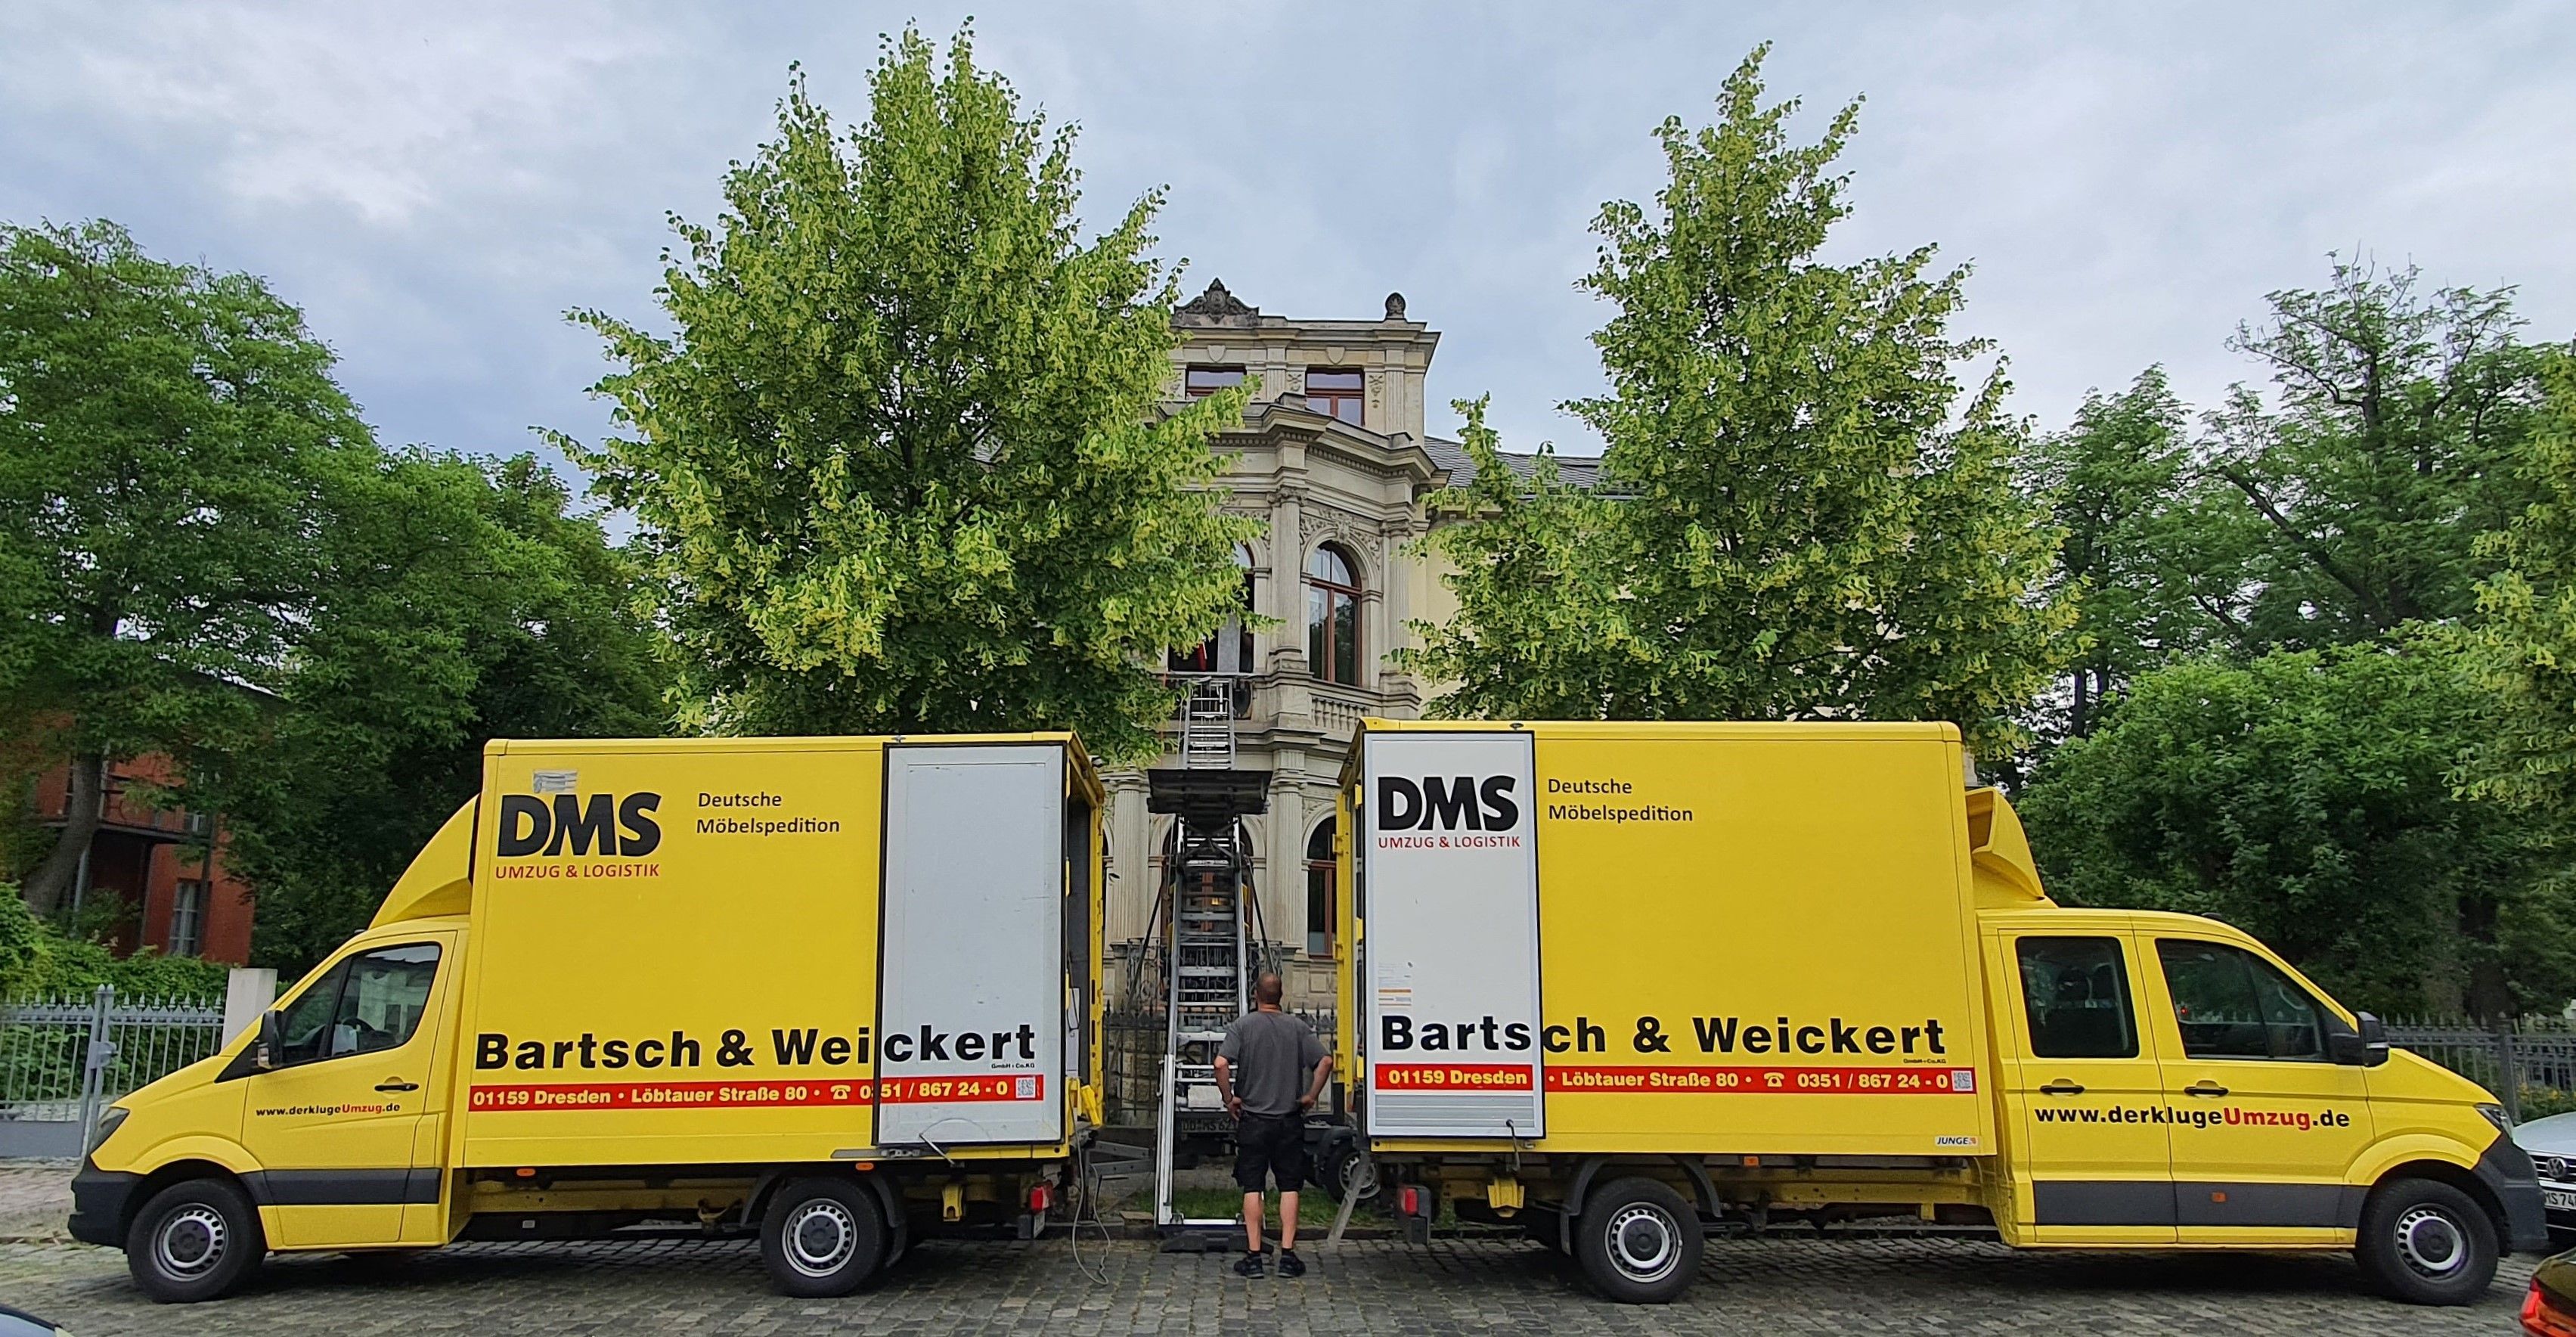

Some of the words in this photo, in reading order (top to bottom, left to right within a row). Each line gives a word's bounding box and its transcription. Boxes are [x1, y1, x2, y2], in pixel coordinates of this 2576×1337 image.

[1548, 778, 1632, 795] Deutsche
[698, 791, 783, 808] Deutsche
[1378, 775, 1519, 832] DMS
[1548, 804, 1694, 824] Möbelspedition
[497, 790, 662, 858] DMS
[696, 817, 840, 836] Möbelspedition
[1378, 836, 1434, 848] UMZUG
[1439, 836, 1449, 848] &
[1455, 835, 1520, 848] LOGISTIK
[495, 866, 560, 879] UMZUG
[566, 865, 578, 879] &
[584, 864, 660, 878] LOGISTIK
[1381, 1015, 1606, 1053] Bartsch
[1633, 1016, 1672, 1053] &
[1692, 1016, 1946, 1054] Weickert
[475, 1031, 700, 1070] Bartsch
[716, 1028, 755, 1068] &
[771, 1024, 1035, 1066] Weickert
[1388, 1069, 1445, 1084] 01159
[1449, 1069, 1527, 1084] Dresden
[1562, 1072, 1644, 1087] Löbtauer
[1649, 1072, 1711, 1087] Straße
[1716, 1072, 1739, 1087] 80
[1796, 1072, 1841, 1087] 0351
[1858, 1074, 1892, 1088] 867
[1897, 1074, 1920, 1088] 24
[1936, 1074, 1948, 1088] 0
[473, 1090, 529, 1106] 01159
[534, 1090, 611, 1104] Dresden
[631, 1087, 715, 1103] Löbtauer
[718, 1086, 780, 1102] Straße
[785, 1086, 808, 1100] 80
[860, 1082, 901, 1100] 051
[919, 1082, 953, 1097] 867
[957, 1081, 981, 1096] 24
[996, 1081, 1008, 1095] 0
[256, 1103, 400, 1117] www.derklugeUmzug.de
[2035, 1106, 2350, 1131] www.derklugeUmzug.de
[1937, 1137, 1968, 1145] JUNGE
